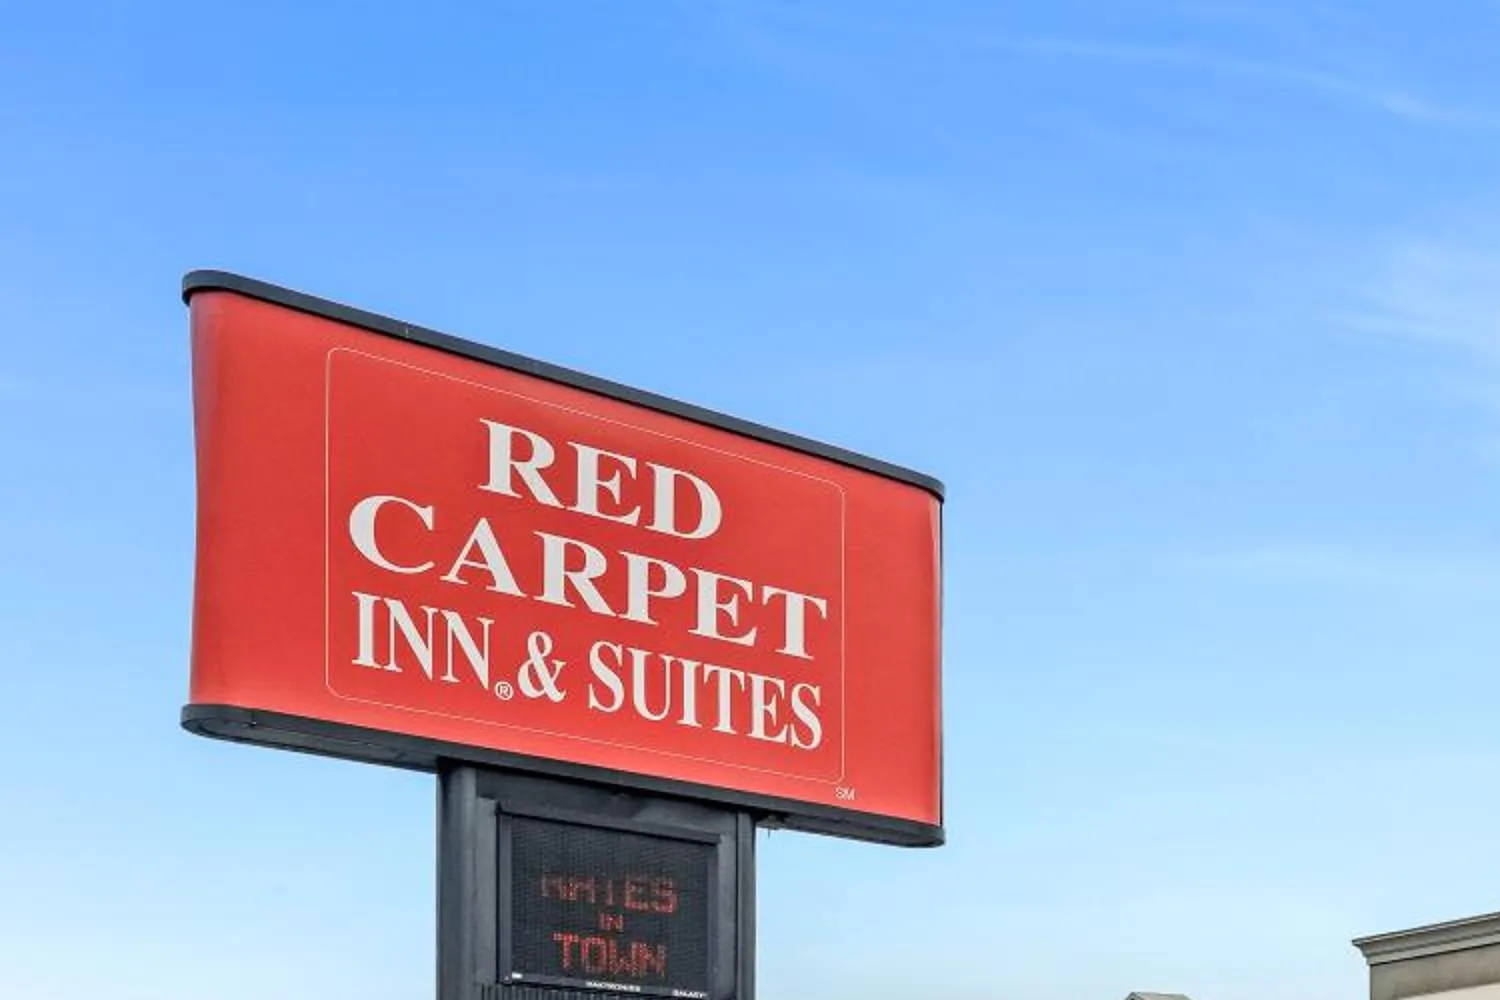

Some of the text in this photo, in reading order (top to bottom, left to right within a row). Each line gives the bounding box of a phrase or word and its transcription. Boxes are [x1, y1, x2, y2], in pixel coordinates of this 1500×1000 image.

[478, 417, 722, 539] RED
[349, 495, 827, 660] CARPET
[517, 631, 567, 703] &
[588, 640, 823, 750] SUITES
[552, 931, 668, 977] TOWN
[599, 912, 624, 932] IN
